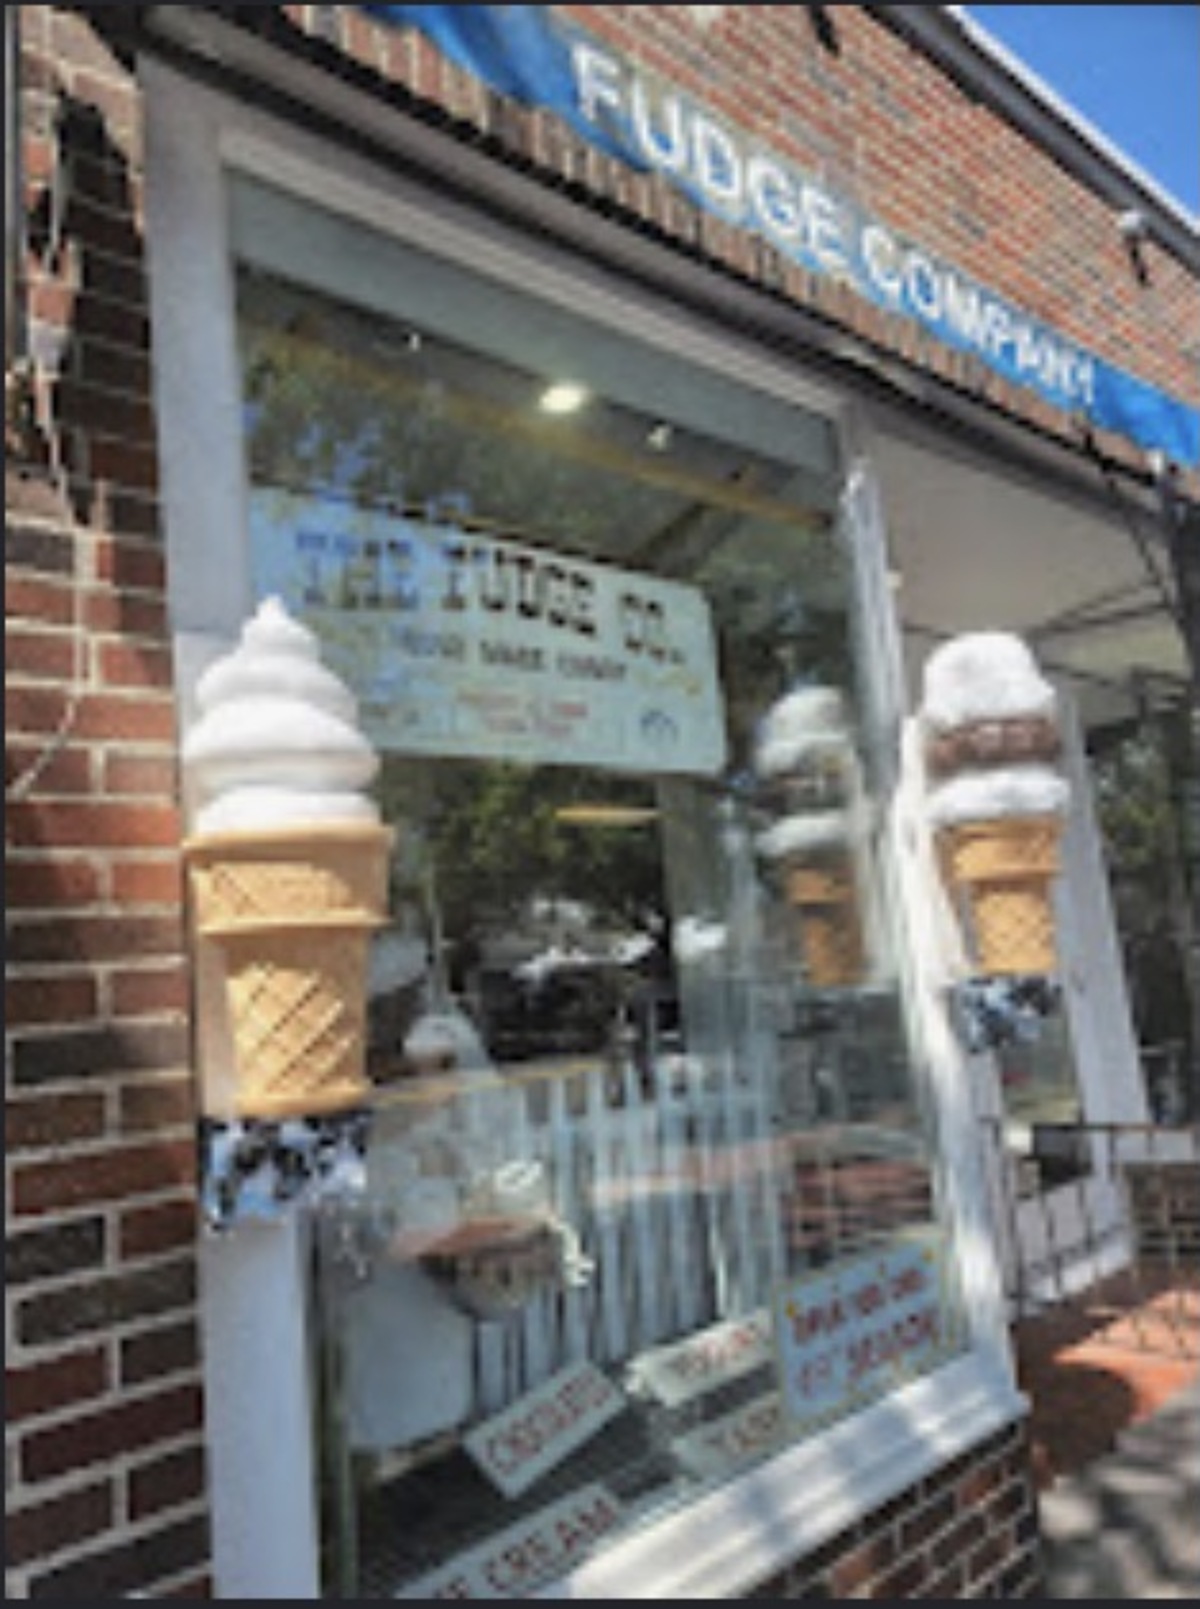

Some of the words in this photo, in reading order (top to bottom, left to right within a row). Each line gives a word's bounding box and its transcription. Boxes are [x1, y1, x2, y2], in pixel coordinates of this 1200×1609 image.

[571, 42, 846, 268] FUDGE
[861, 223, 1094, 405] COMPANY
[295, 528, 419, 609] THE
